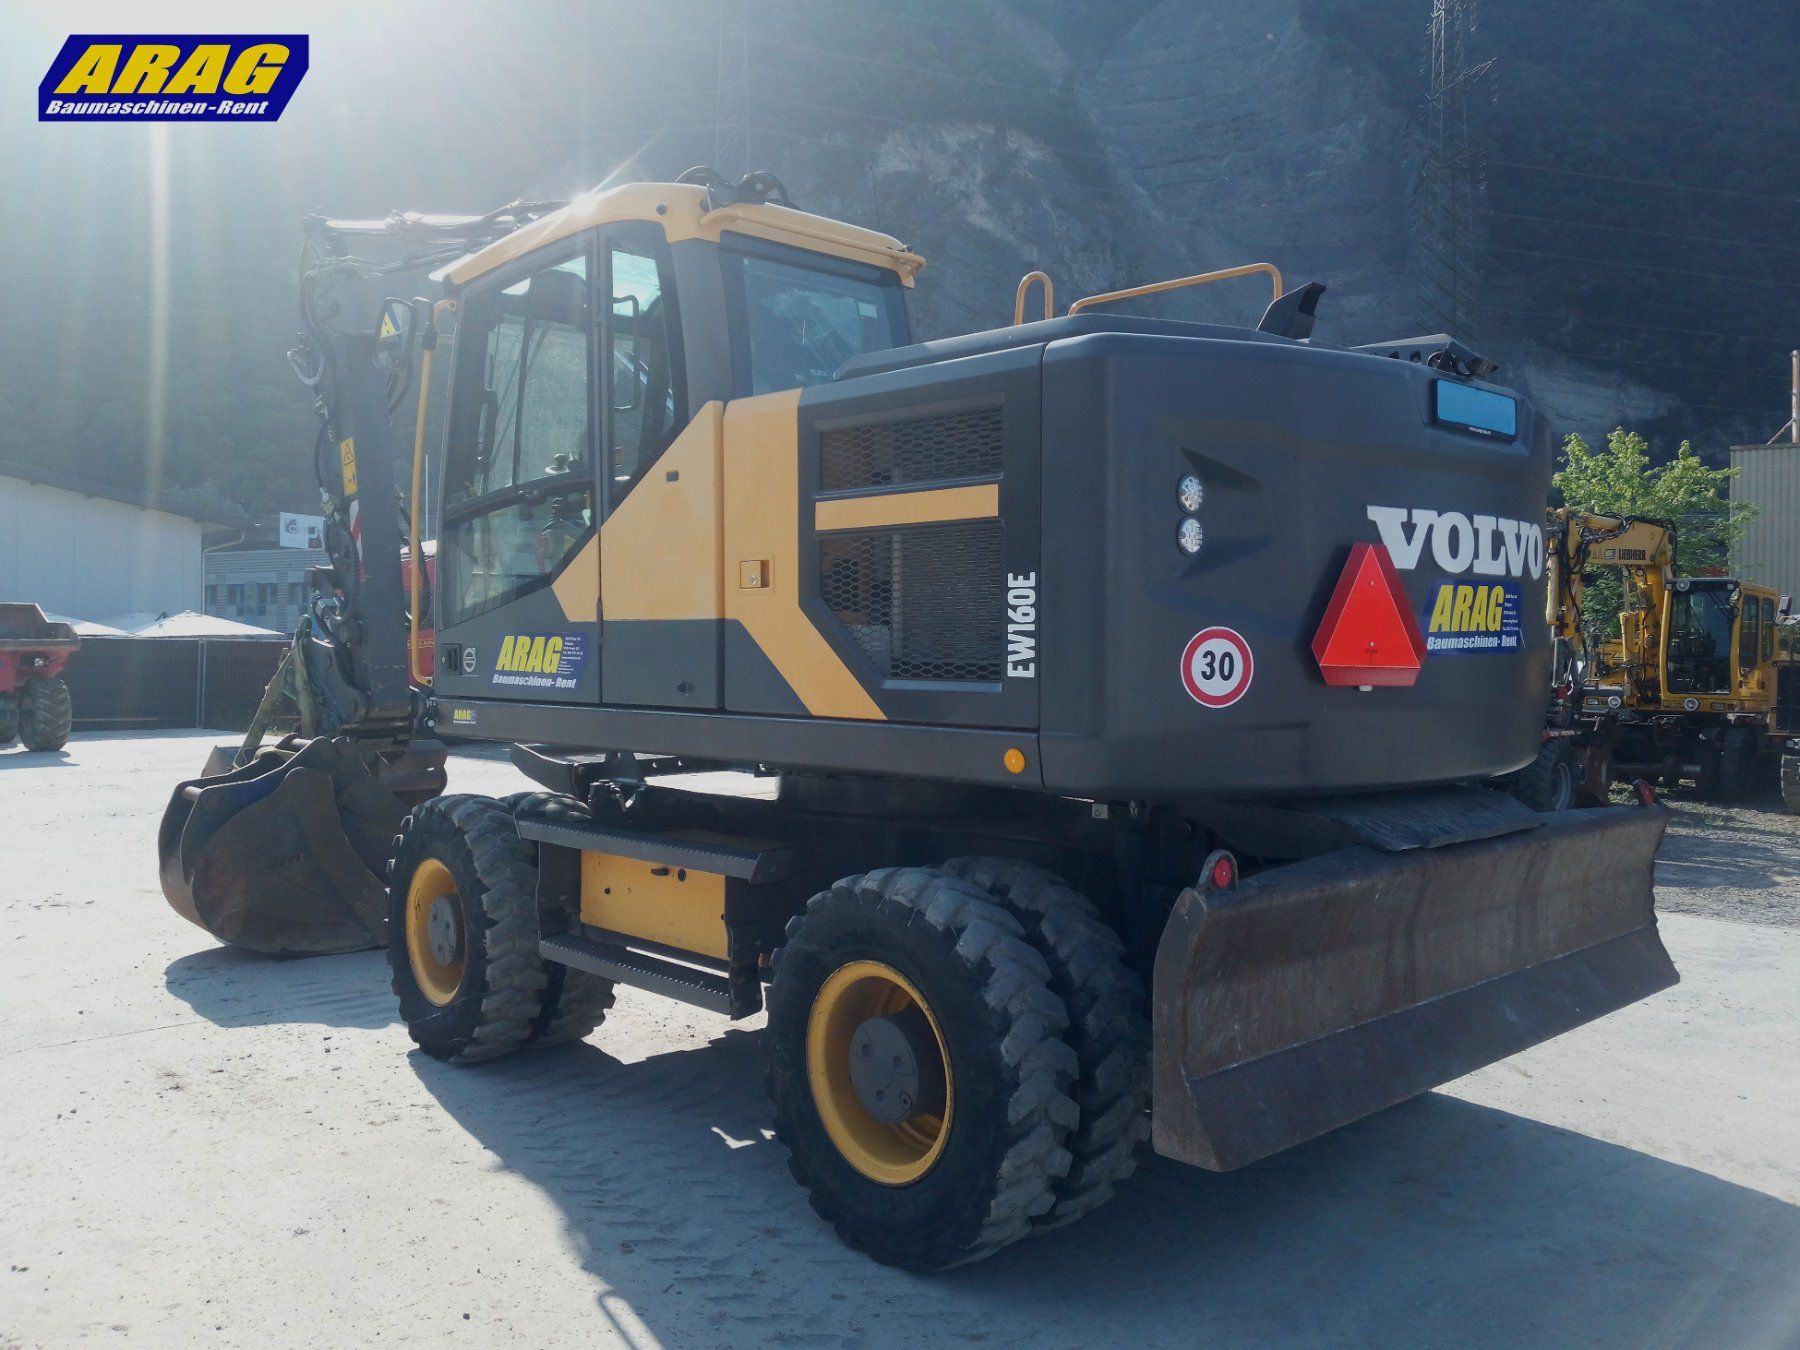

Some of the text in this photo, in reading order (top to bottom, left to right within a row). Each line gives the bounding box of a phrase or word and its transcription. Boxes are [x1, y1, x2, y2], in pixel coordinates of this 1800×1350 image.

[1366, 504, 1543, 581] VOLVO
[1618, 548, 1646, 561] LIEBHERR
[1007, 571, 1036, 678] EW160E
[1428, 585, 1505, 632] ARAG
[495, 635, 563, 674] ARAG
[1501, 634, 1517, 647] Rent
[1201, 650, 1235, 682] 30
[555, 676, 577, 689] Rent
[453, 709, 472, 721] ARAG
